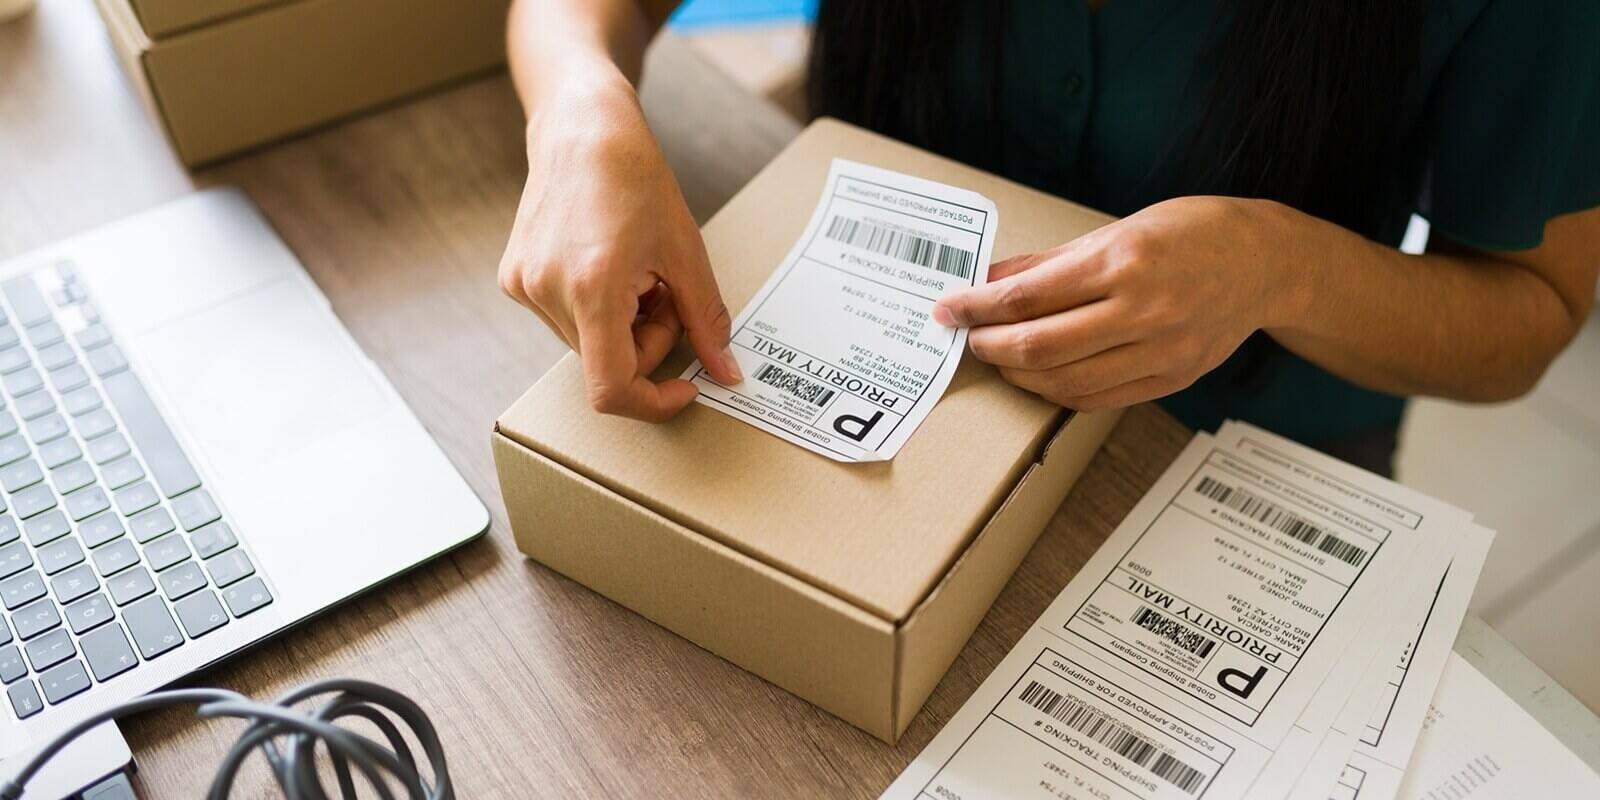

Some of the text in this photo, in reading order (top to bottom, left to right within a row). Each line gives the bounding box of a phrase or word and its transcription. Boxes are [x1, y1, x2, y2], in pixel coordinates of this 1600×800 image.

[881, 193, 897, 204] FOR
[897, 197, 938, 215] APPROVED
[938, 208, 973, 224] POSTAGE
[847, 254, 897, 275] TRACKING
[897, 269, 945, 291] SHIPPING
[865, 294, 878, 302] FL
[842, 304, 920, 337] SHORT STREET 12
[900, 305, 930, 320] SMALL
[905, 317, 925, 329] USA
[848, 342, 874, 357] 12345
[882, 329, 944, 356] PAULA MILLER
[864, 359, 899, 379] STREET
[874, 354, 889, 363] AZ
[752, 334, 899, 408] PRIORITY MAIL
[837, 356, 918, 396] VERONICA BROWN
[911, 369, 929, 381] BIG
[899, 375, 923, 389] MAIN
[727, 393, 831, 444] Global Shipping Company
[831, 409, 885, 443] P
[1218, 511, 1272, 540] TRACKING
[1272, 537, 1326, 565] SHIPPING
[1126, 560, 1153, 577] 0008
[1229, 560, 1265, 581] STREET
[1266, 577, 1298, 597] SHORT
[1282, 577, 1303, 591] USA
[1225, 592, 1252, 609] 12345
[1258, 583, 1325, 618] PEDRO JONES
[1123, 576, 1282, 664] PRIORITY MAIL
[1252, 606, 1268, 617] AZ
[1229, 604, 1306, 645] MAIN STREET 89
[1235, 615, 1301, 652] MARK GARCIA
[1291, 625, 1311, 639] BIG
[1107, 638, 1218, 700] Global Shipping Company
[1215, 664, 1269, 700] P
[1050, 658, 1216, 752] POSTAGE APPROVED FOR SHIPPING
[1032, 718, 1158, 793] SHIPPING TRACKING #
[1071, 775, 1085, 787] FL
